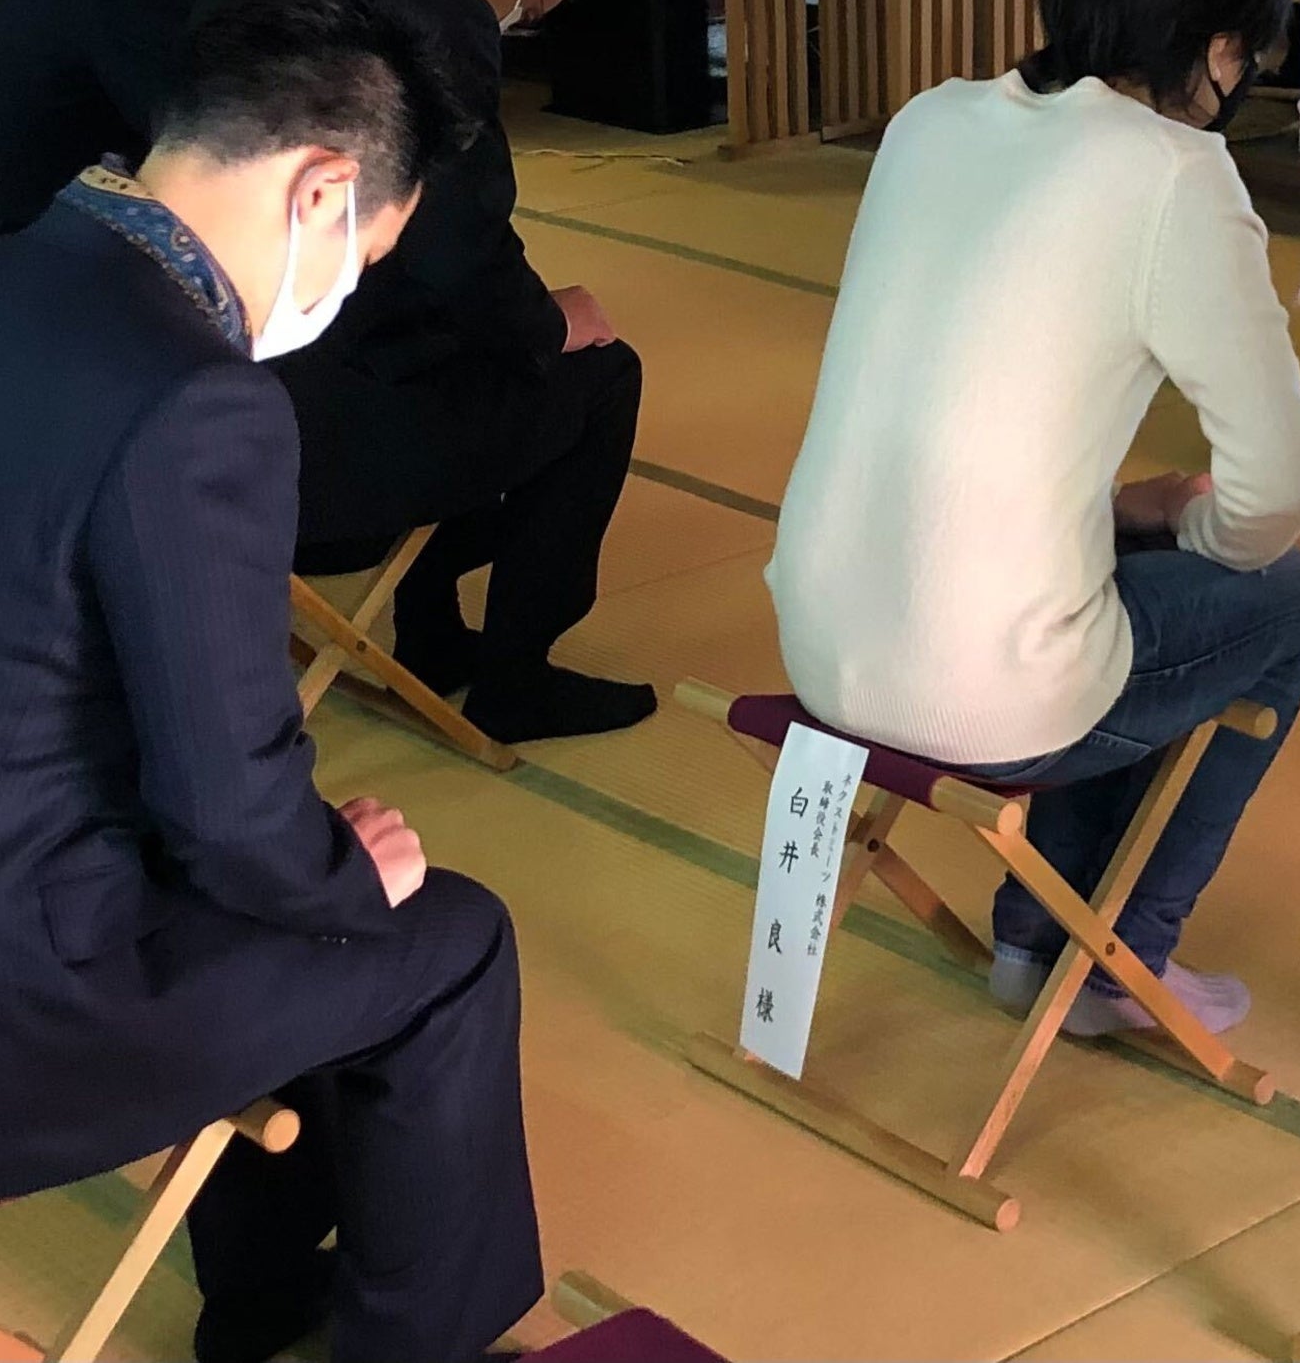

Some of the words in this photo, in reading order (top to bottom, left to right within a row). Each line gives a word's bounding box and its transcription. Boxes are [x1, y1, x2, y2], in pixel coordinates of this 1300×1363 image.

[809, 779, 834, 860] 取締役会長
[806, 892, 828, 957] 株式会社
